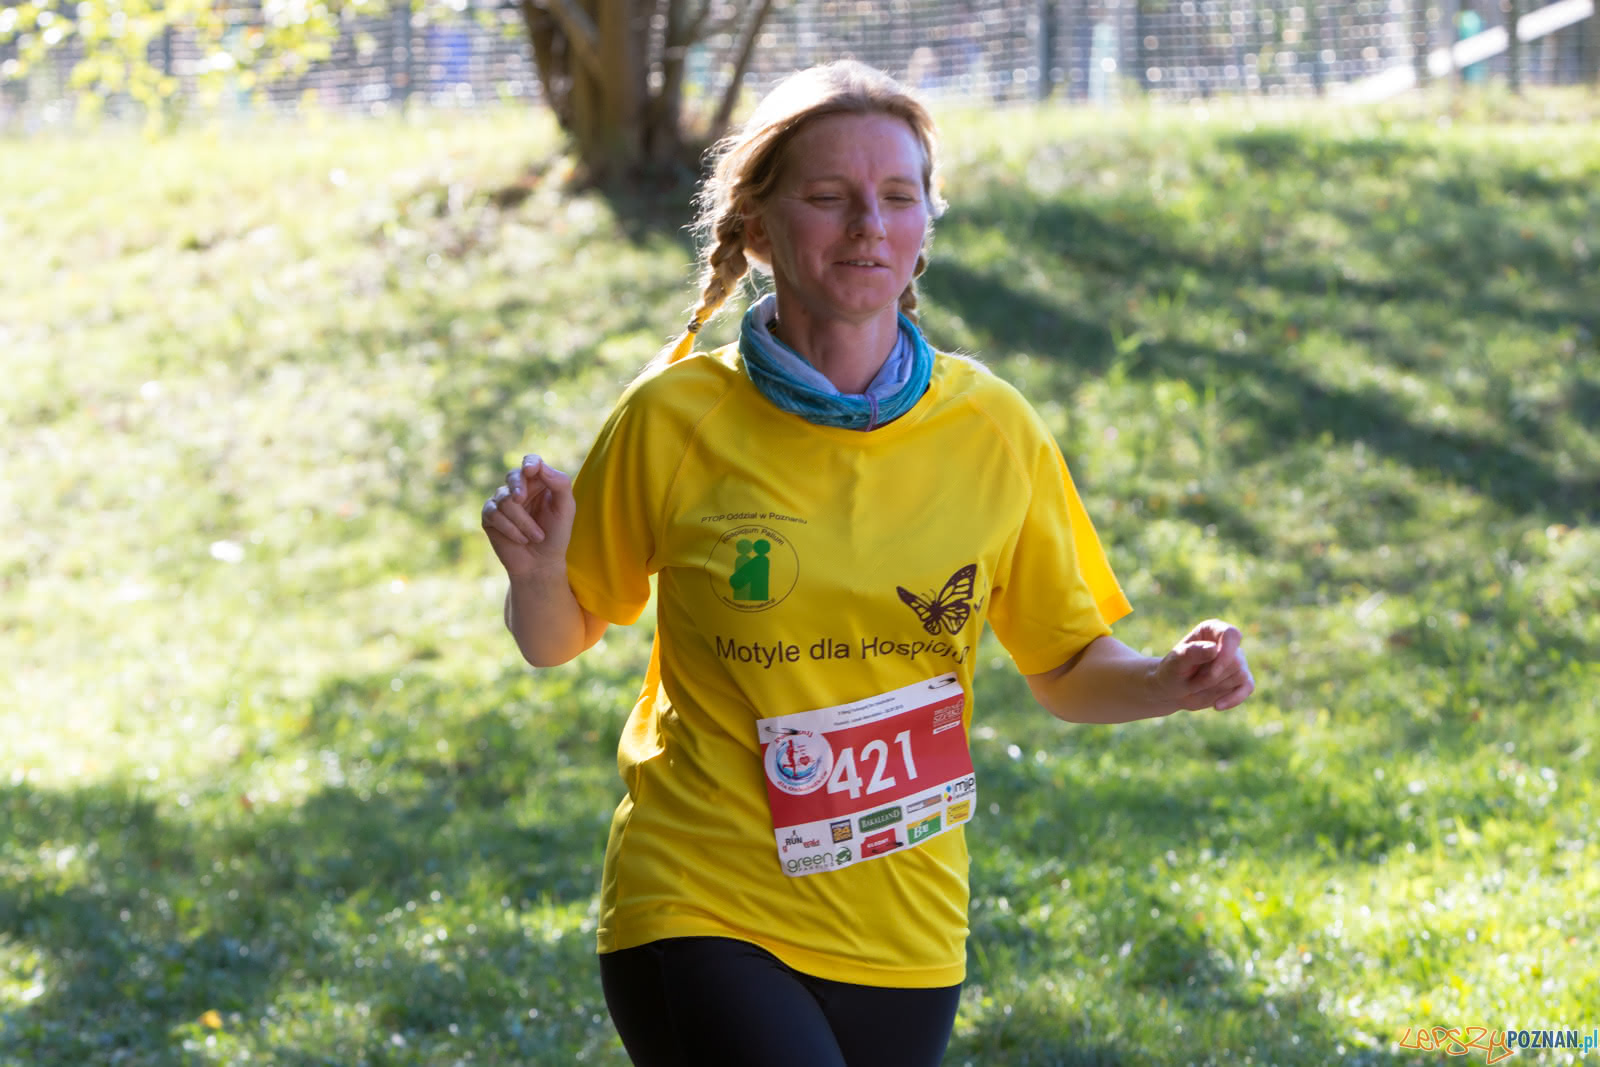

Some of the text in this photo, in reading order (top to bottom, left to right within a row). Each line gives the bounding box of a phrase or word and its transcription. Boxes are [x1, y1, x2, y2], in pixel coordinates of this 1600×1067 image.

[701, 514, 725, 524] PTOP
[715, 636, 800, 669] Motyle
[809, 638, 850, 660] dla
[826, 729, 919, 800] 421
[786, 852, 834, 874] green
